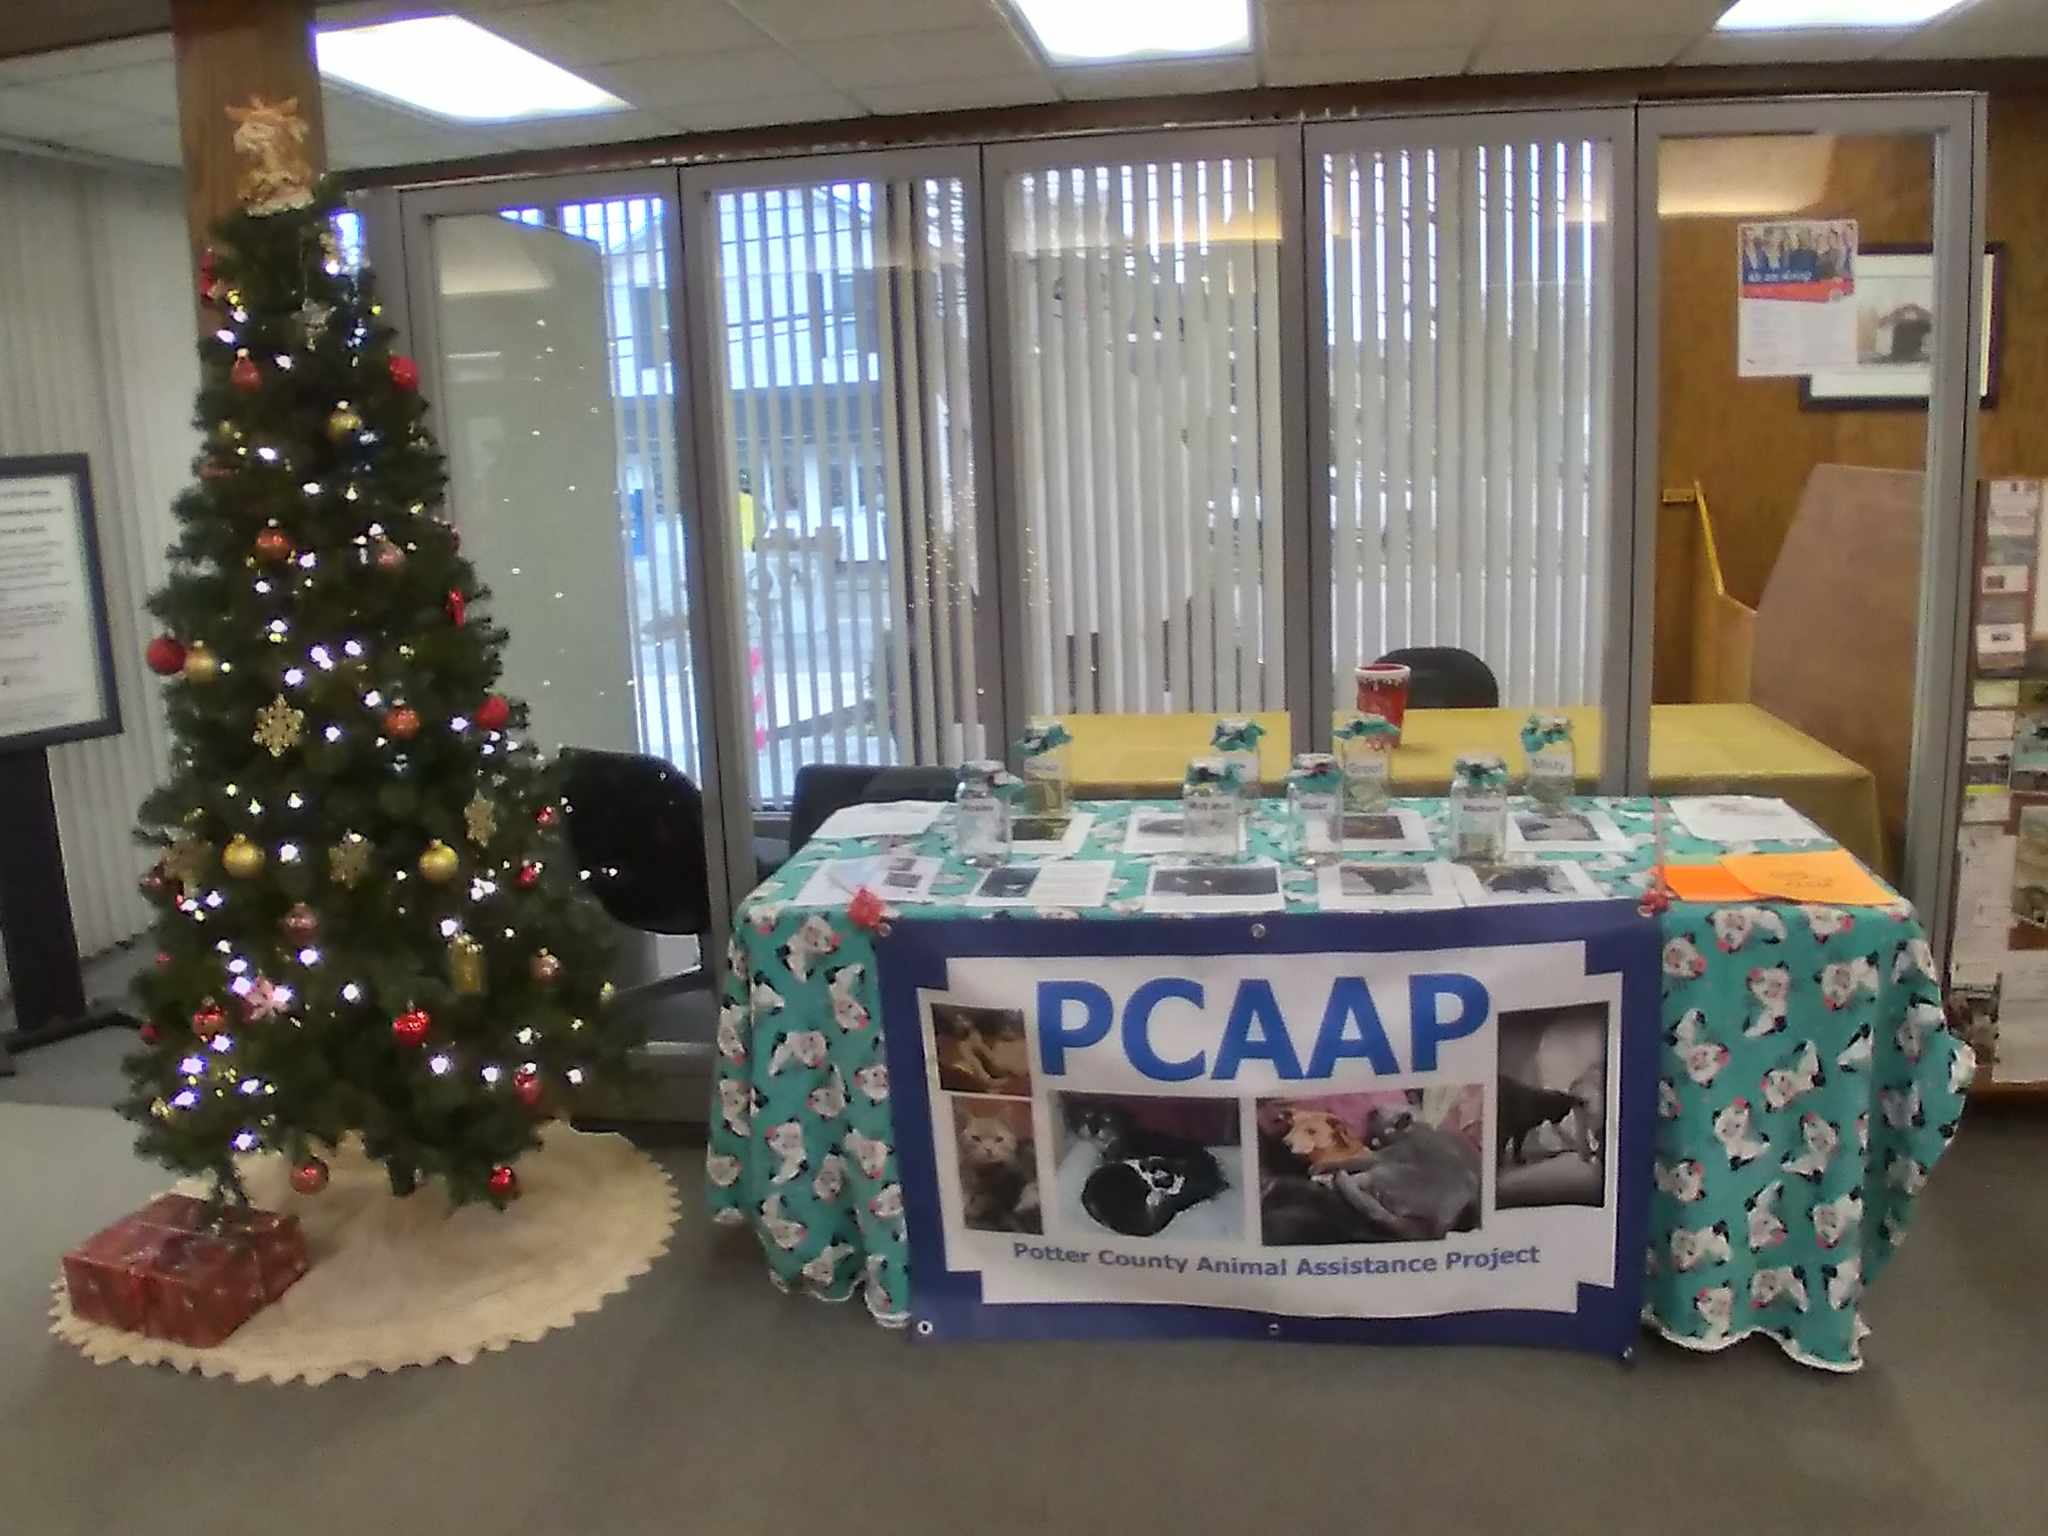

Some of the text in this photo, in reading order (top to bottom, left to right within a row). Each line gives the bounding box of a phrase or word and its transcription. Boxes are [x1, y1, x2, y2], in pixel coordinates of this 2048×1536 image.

[1036, 973, 1490, 1082] PCAAP
[1013, 1242, 1541, 1277] Potter County Animal Assistance Project
